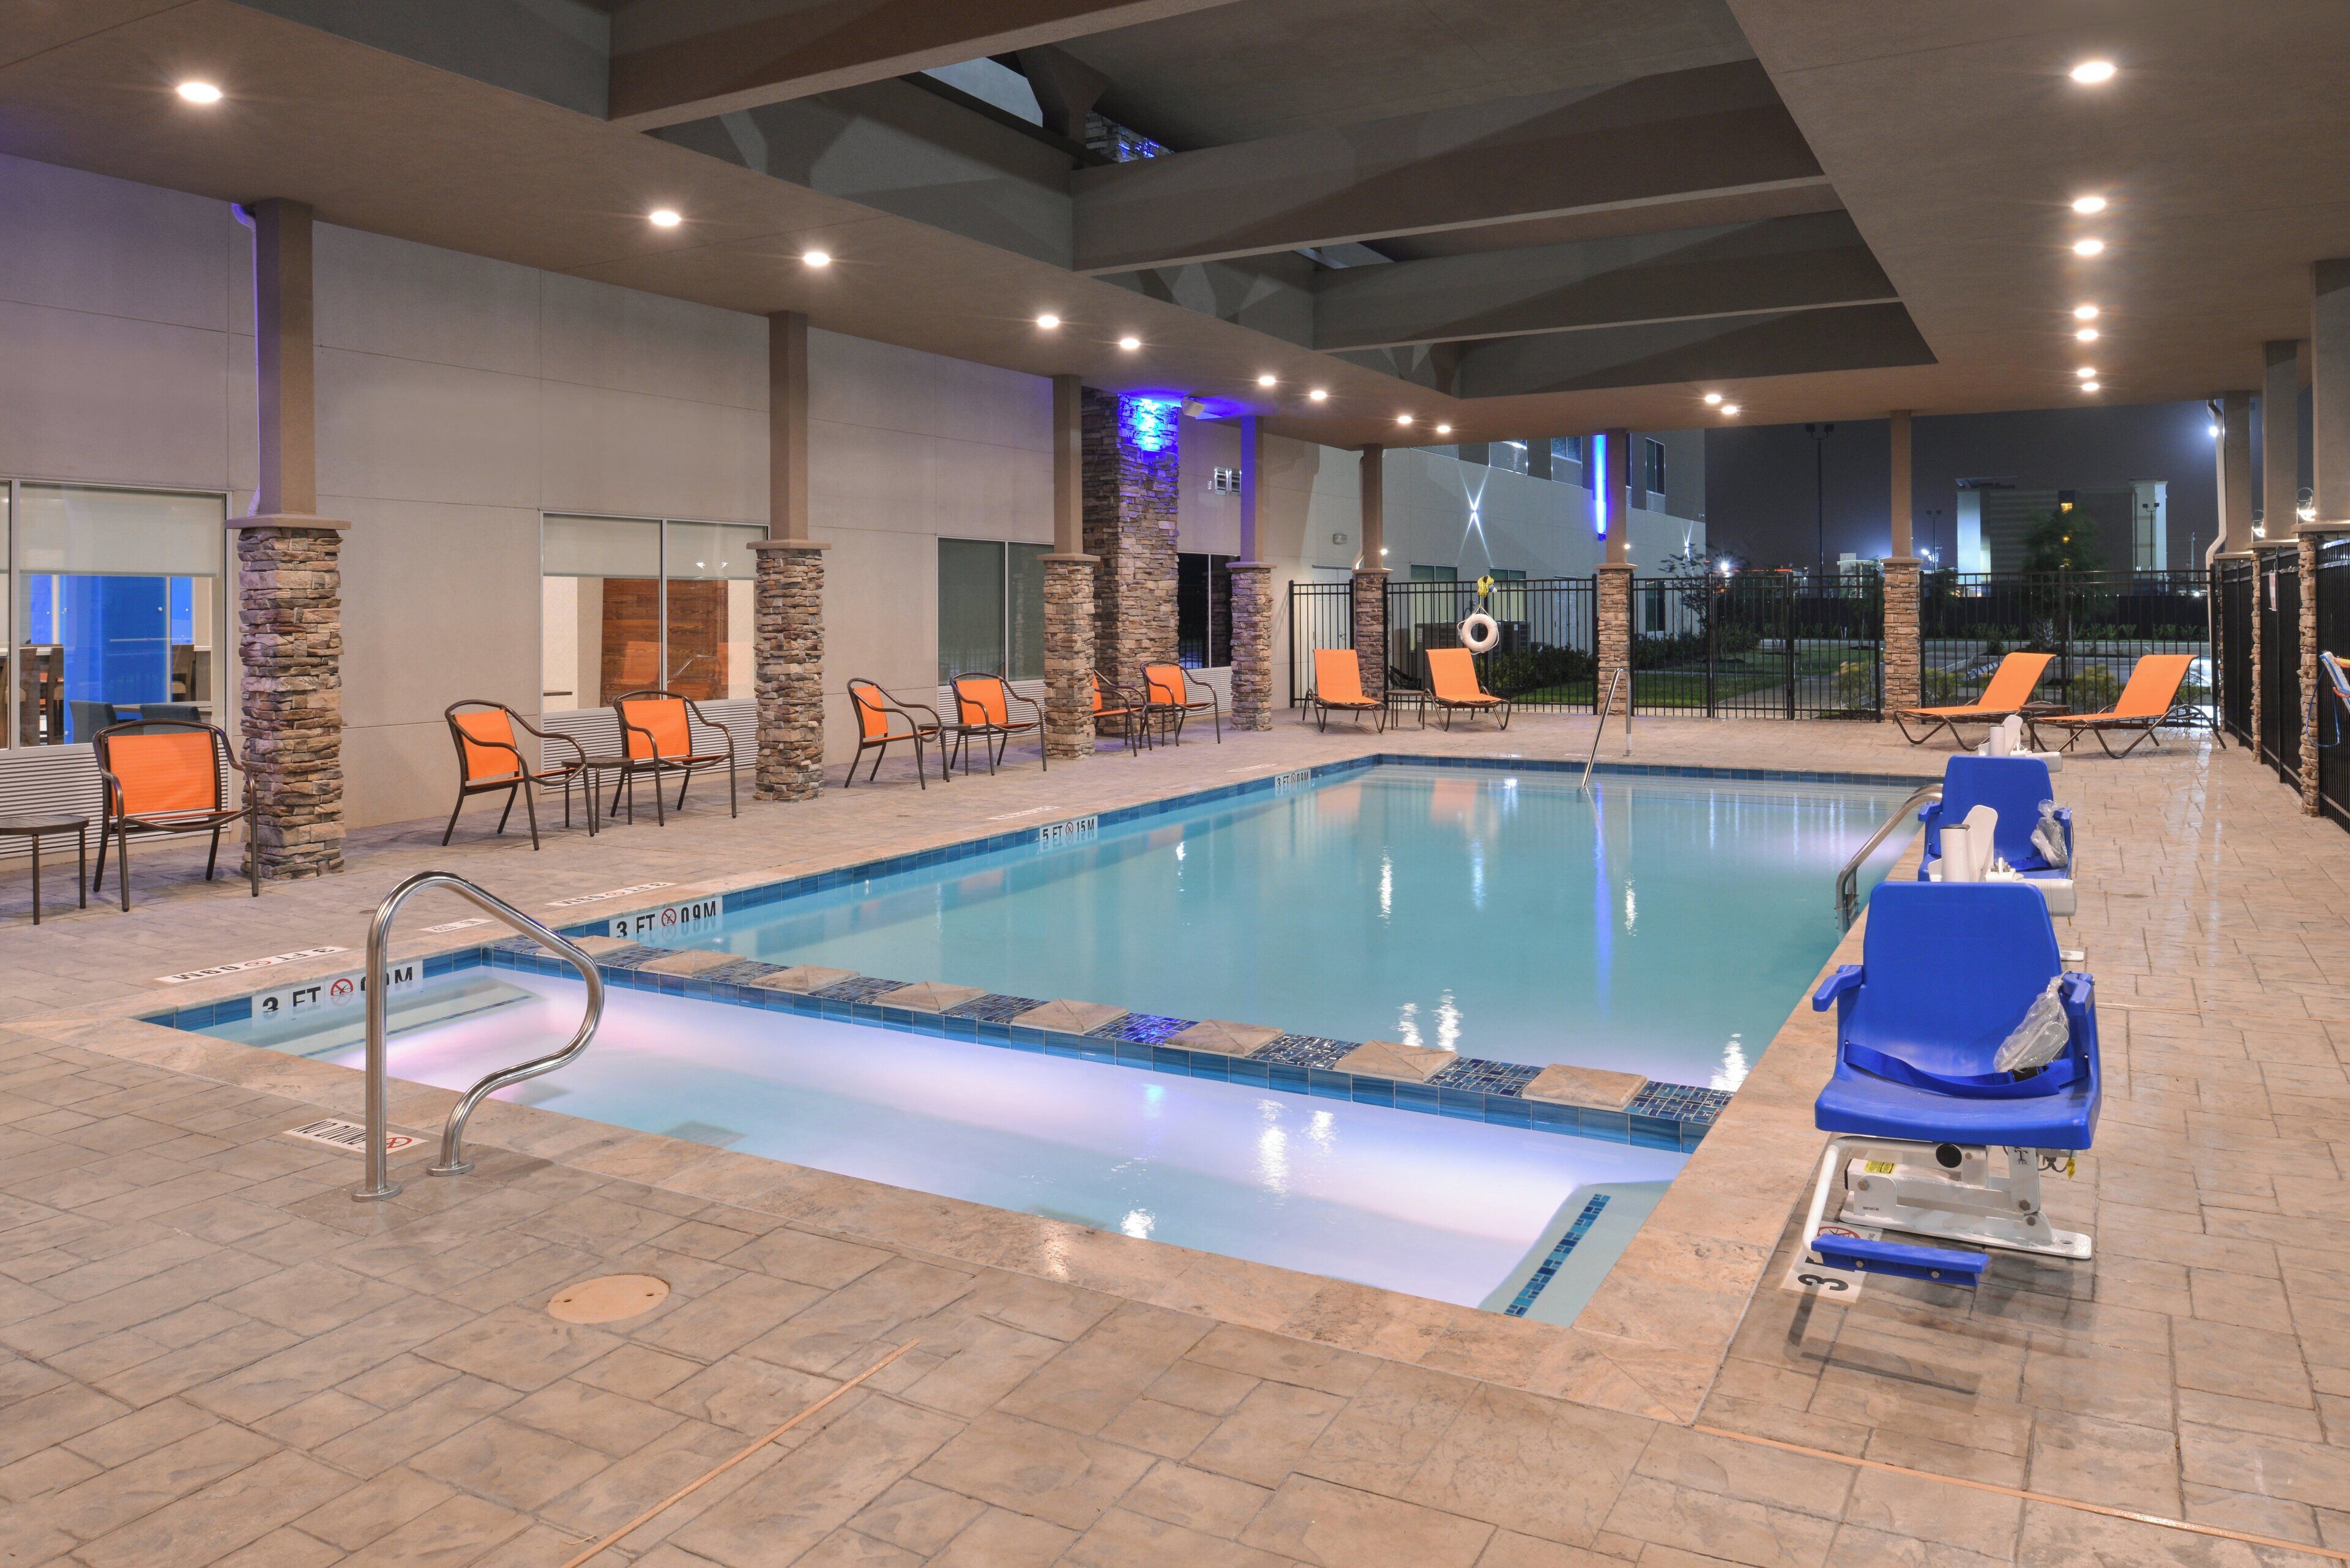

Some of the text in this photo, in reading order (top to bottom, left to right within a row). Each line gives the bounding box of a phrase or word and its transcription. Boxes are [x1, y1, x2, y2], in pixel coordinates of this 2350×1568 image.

[1277, 777, 1281, 787] 3
[1283, 775, 1289, 785] FT
[1043, 828, 1048, 840] 5
[1053, 825, 1062, 838] FT
[617, 920, 628, 938] 3
[636, 913, 655, 934] FT
[275, 953, 309, 961] FT
[263, 996, 279, 1013] 3
[293, 986, 321, 1007] FT
[293, 1120, 338, 1133] NO
[1797, 1274, 1849, 1291] 3
